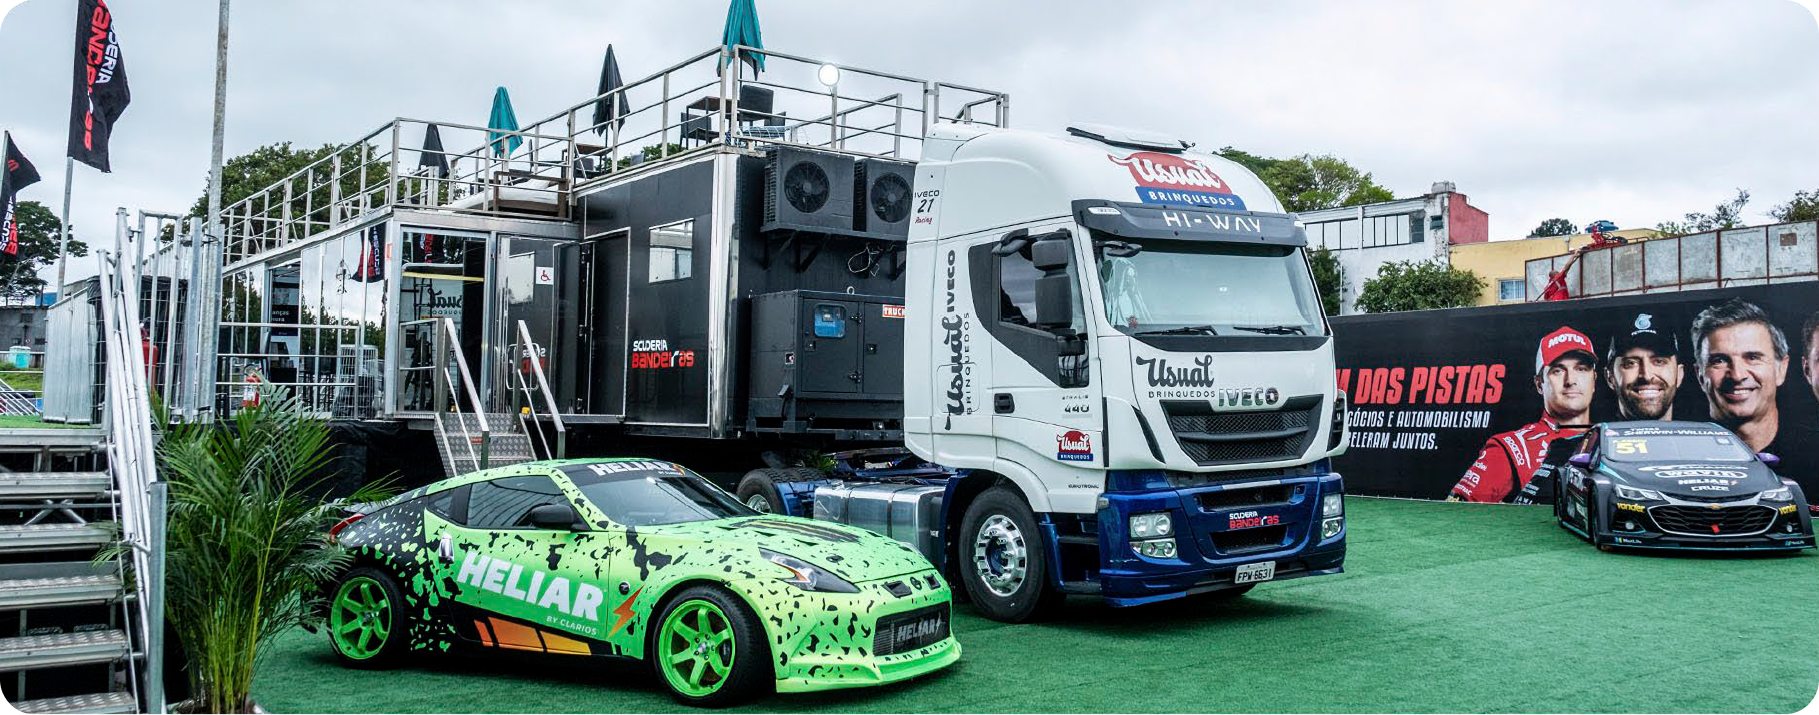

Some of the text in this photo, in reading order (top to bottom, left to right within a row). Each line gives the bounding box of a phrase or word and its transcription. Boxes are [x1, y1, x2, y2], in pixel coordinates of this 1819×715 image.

[1112, 154, 1221, 189] Usual
[915, 190, 940, 198] IVECO
[1149, 190, 1236, 207] BRINQUEDOS
[917, 198, 935, 213] 21
[1162, 211, 1262, 233] HI-WAY
[946, 249, 956, 313] IVECO
[633, 339, 668, 352] SCUDERIA
[1548, 333, 1587, 349] MOTUL
[941, 313, 965, 431] Usual
[963, 312, 973, 415] BRINQUEDOS
[1135, 354, 1215, 388] Usual
[1148, 390, 1216, 398] BRINQUEDOS
[1354, 367, 1406, 404] DAS
[1408, 364, 1506, 404] PISTAS
[1218, 387, 1280, 407] IVECO
[1064, 404, 1090, 413] 440
[1347, 408, 1491, 428] GÓCIOS E AUTOMOBILISMO
[1348, 431, 1438, 450] ELERAM JUNTOS.
[1615, 441, 1649, 454] 51
[587, 461, 679, 476] HELIAR
[456, 549, 604, 622] HELIAR
[546, 615, 598, 636] BY CLARIOS
[896, 618, 936, 642] HELIAR
